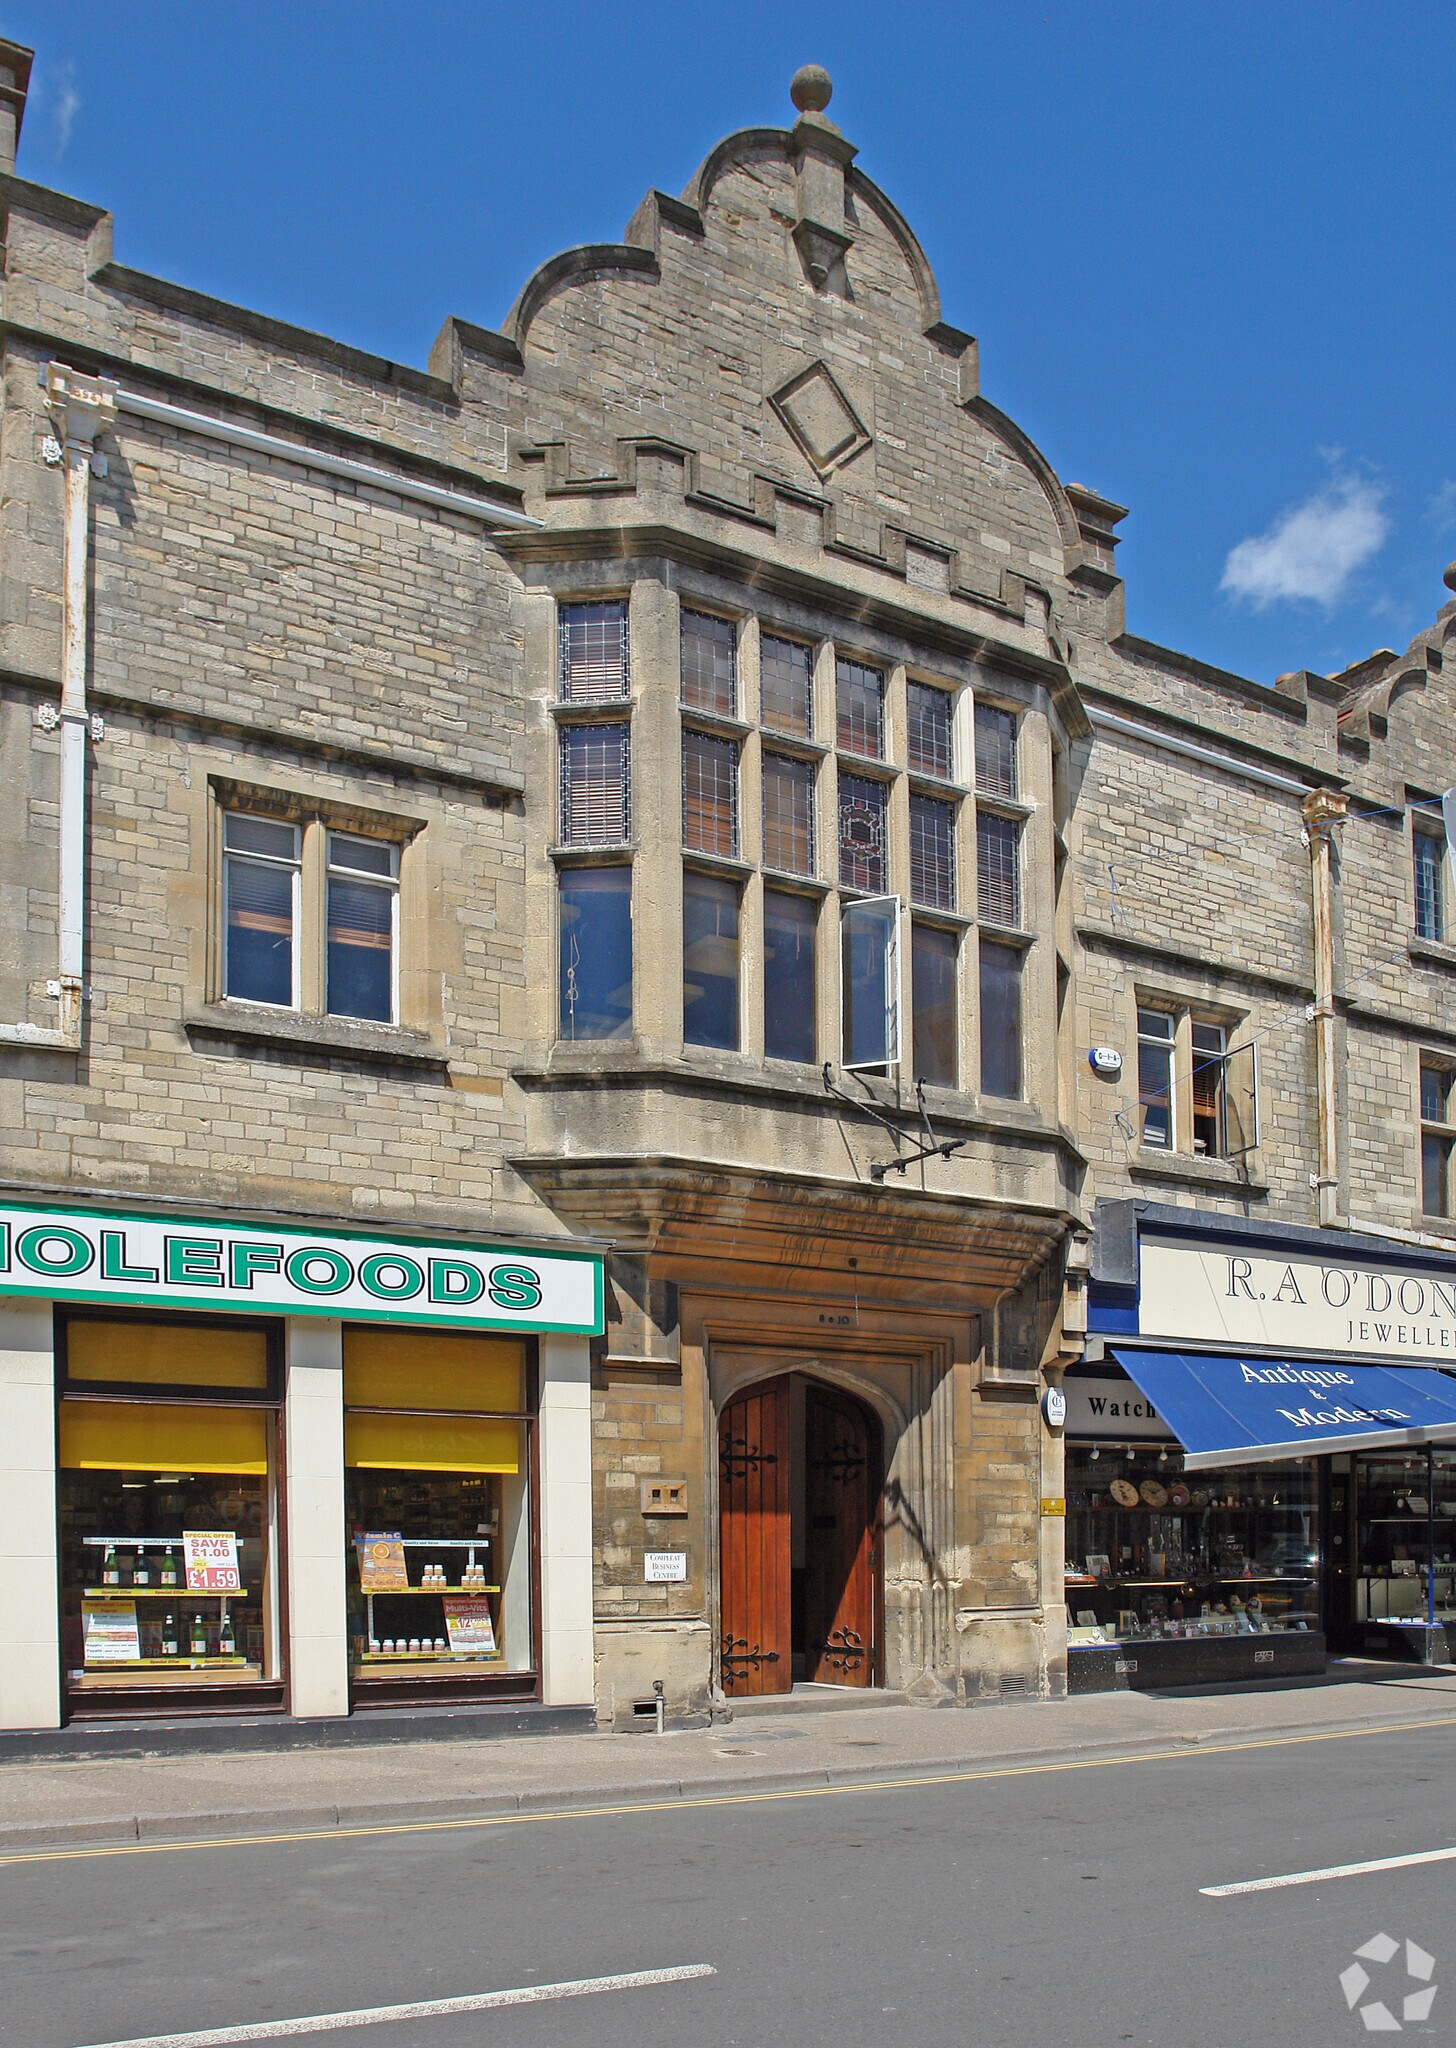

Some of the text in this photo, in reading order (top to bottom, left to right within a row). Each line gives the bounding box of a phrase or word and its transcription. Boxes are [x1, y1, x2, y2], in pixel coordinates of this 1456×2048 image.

[0, 1222, 542, 1310] OLEFOODS
[1347, 1320, 1456, 1348] JEWELLE
[1240, 1362, 1354, 1388] Antique
[1309, 1389, 1327, 1400] &
[1276, 1406, 1411, 1427] Modern
[191, 1539, 228, 1548] SAVE
[192, 1548, 230, 1557] £1.00
[189, 1571, 236, 1588] £1.59
